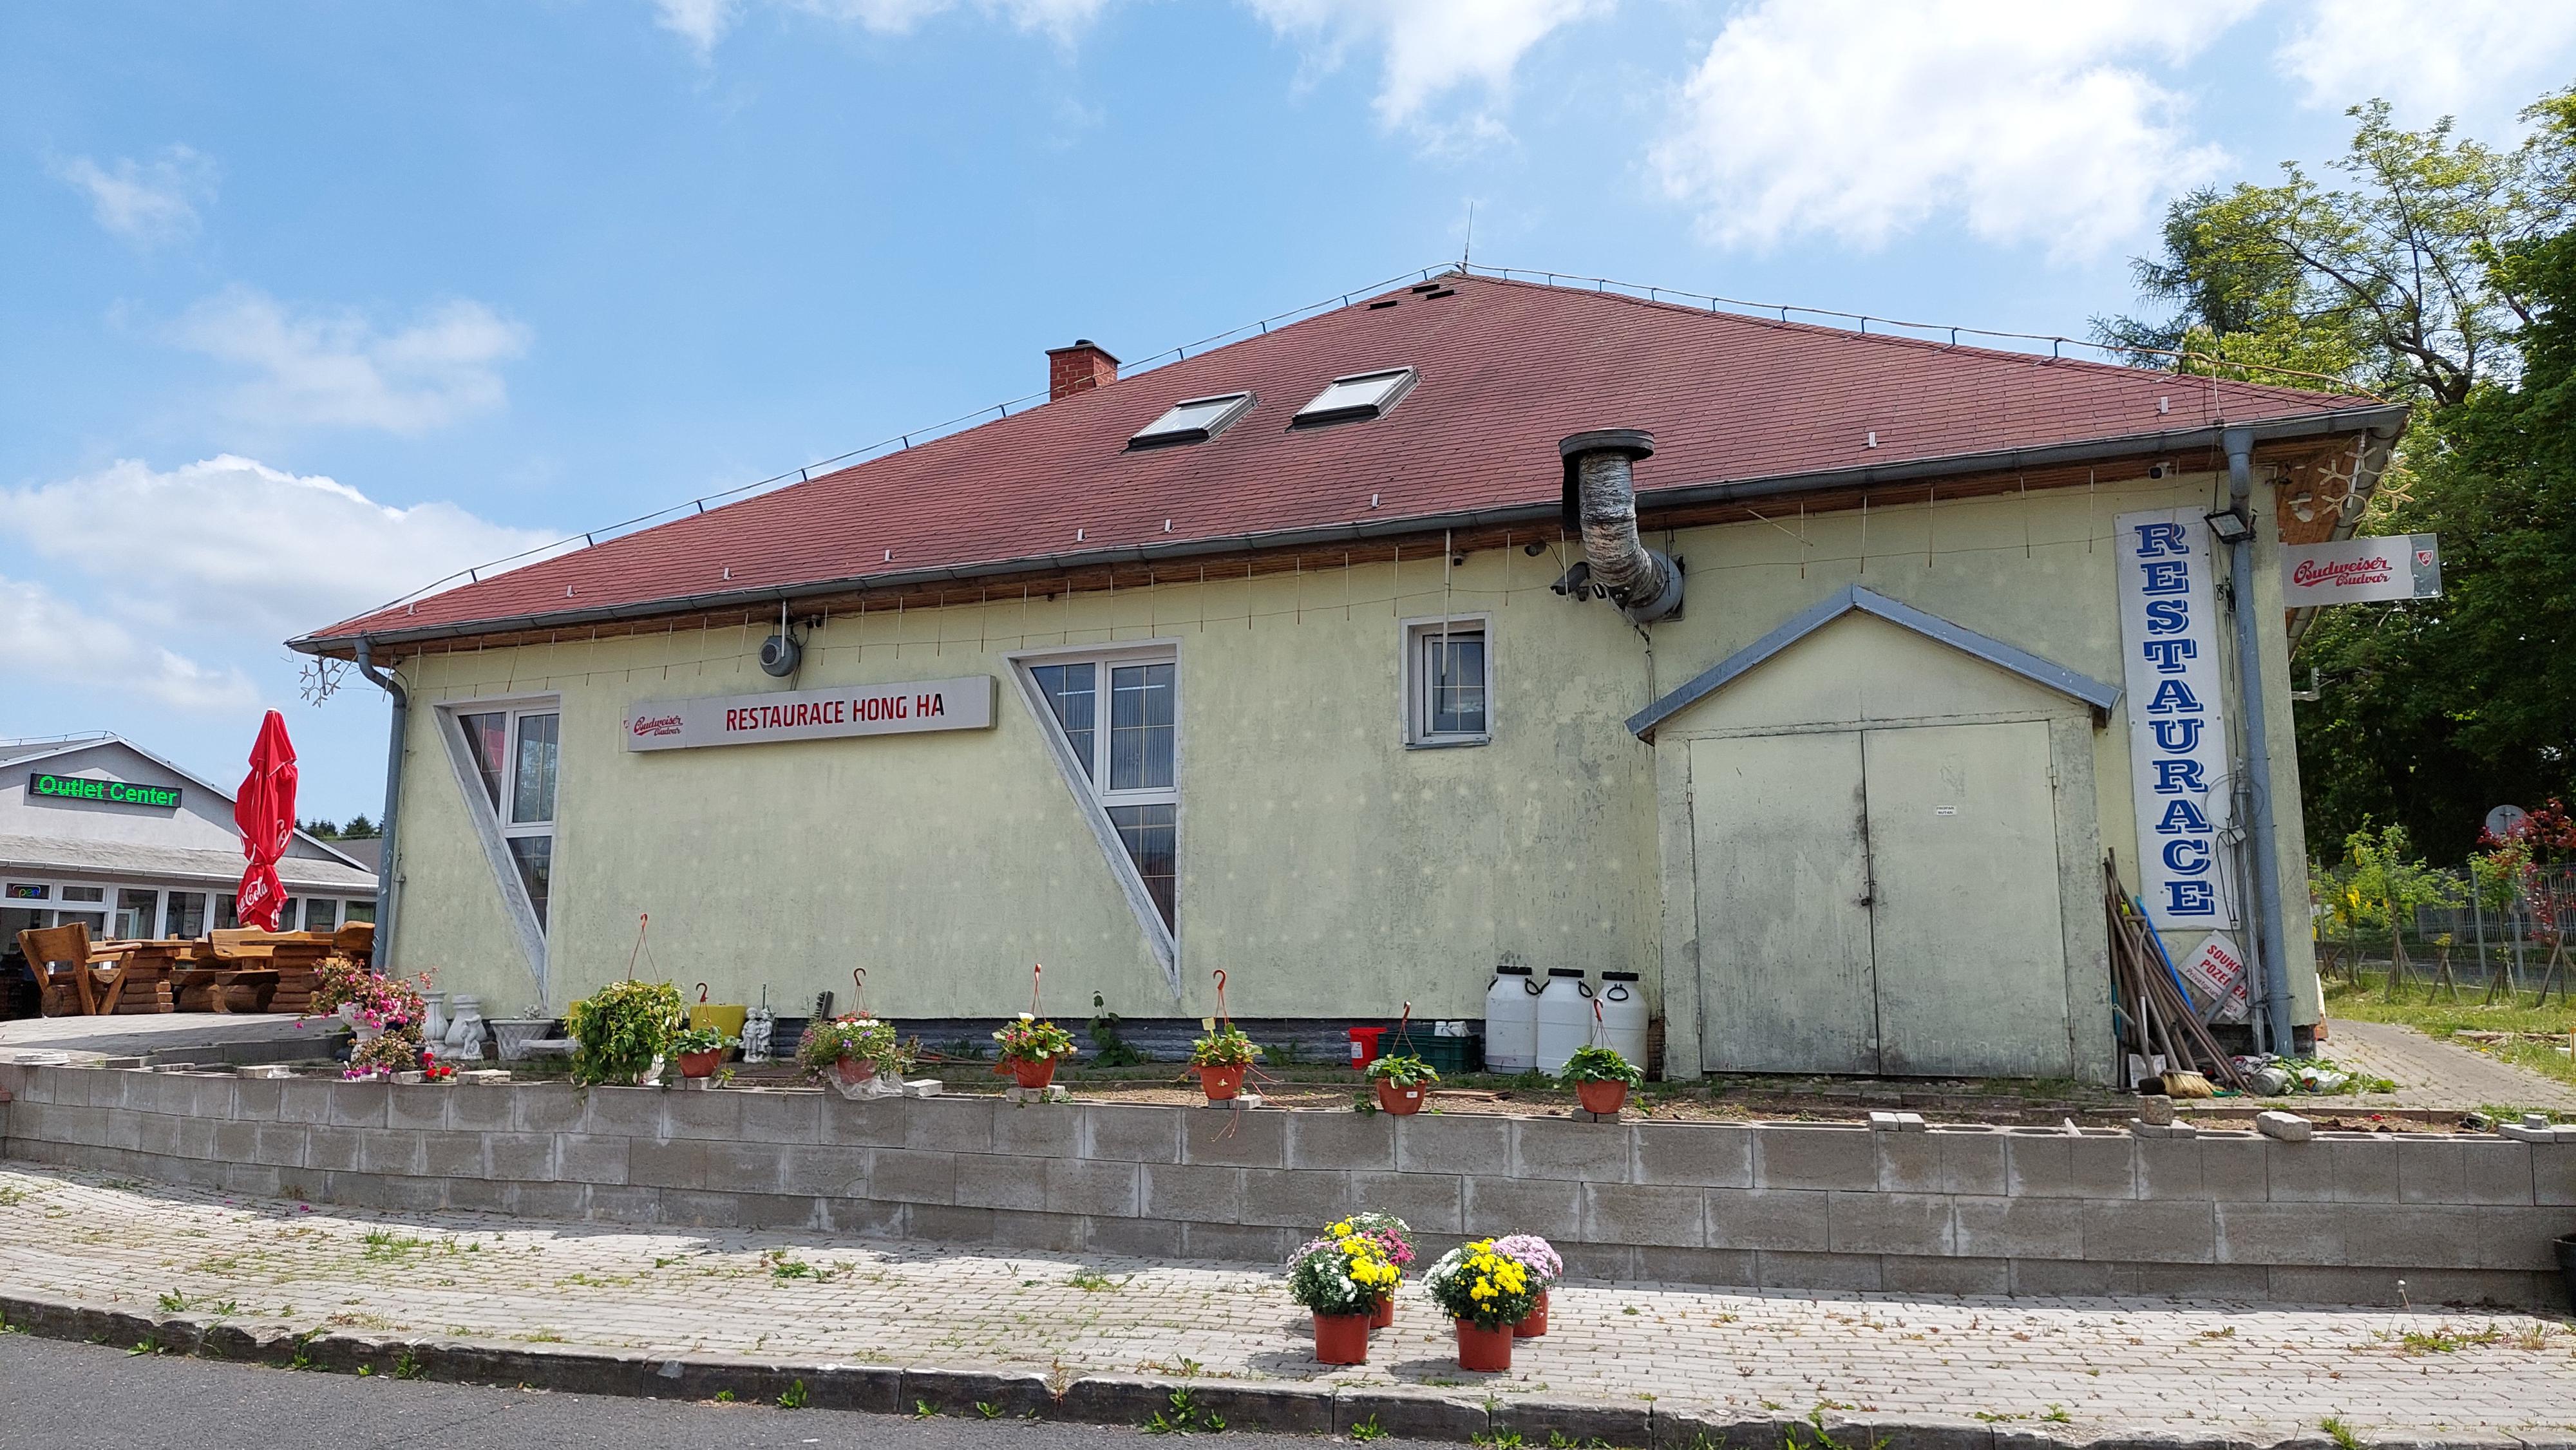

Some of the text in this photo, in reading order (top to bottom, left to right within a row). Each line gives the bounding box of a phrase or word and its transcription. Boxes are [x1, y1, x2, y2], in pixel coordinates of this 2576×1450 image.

[2293, 557, 2392, 587] Budweiser
[2335, 572, 2391, 587] Budvar
[634, 715, 683, 736] Budweiser
[726, 693, 945, 731] RESTAURACE HONG HA
[2134, 522, 2215, 916] RESTAURACE
[654, 728, 681, 736] Budvar
[39, 775, 178, 805] Outlet Center
